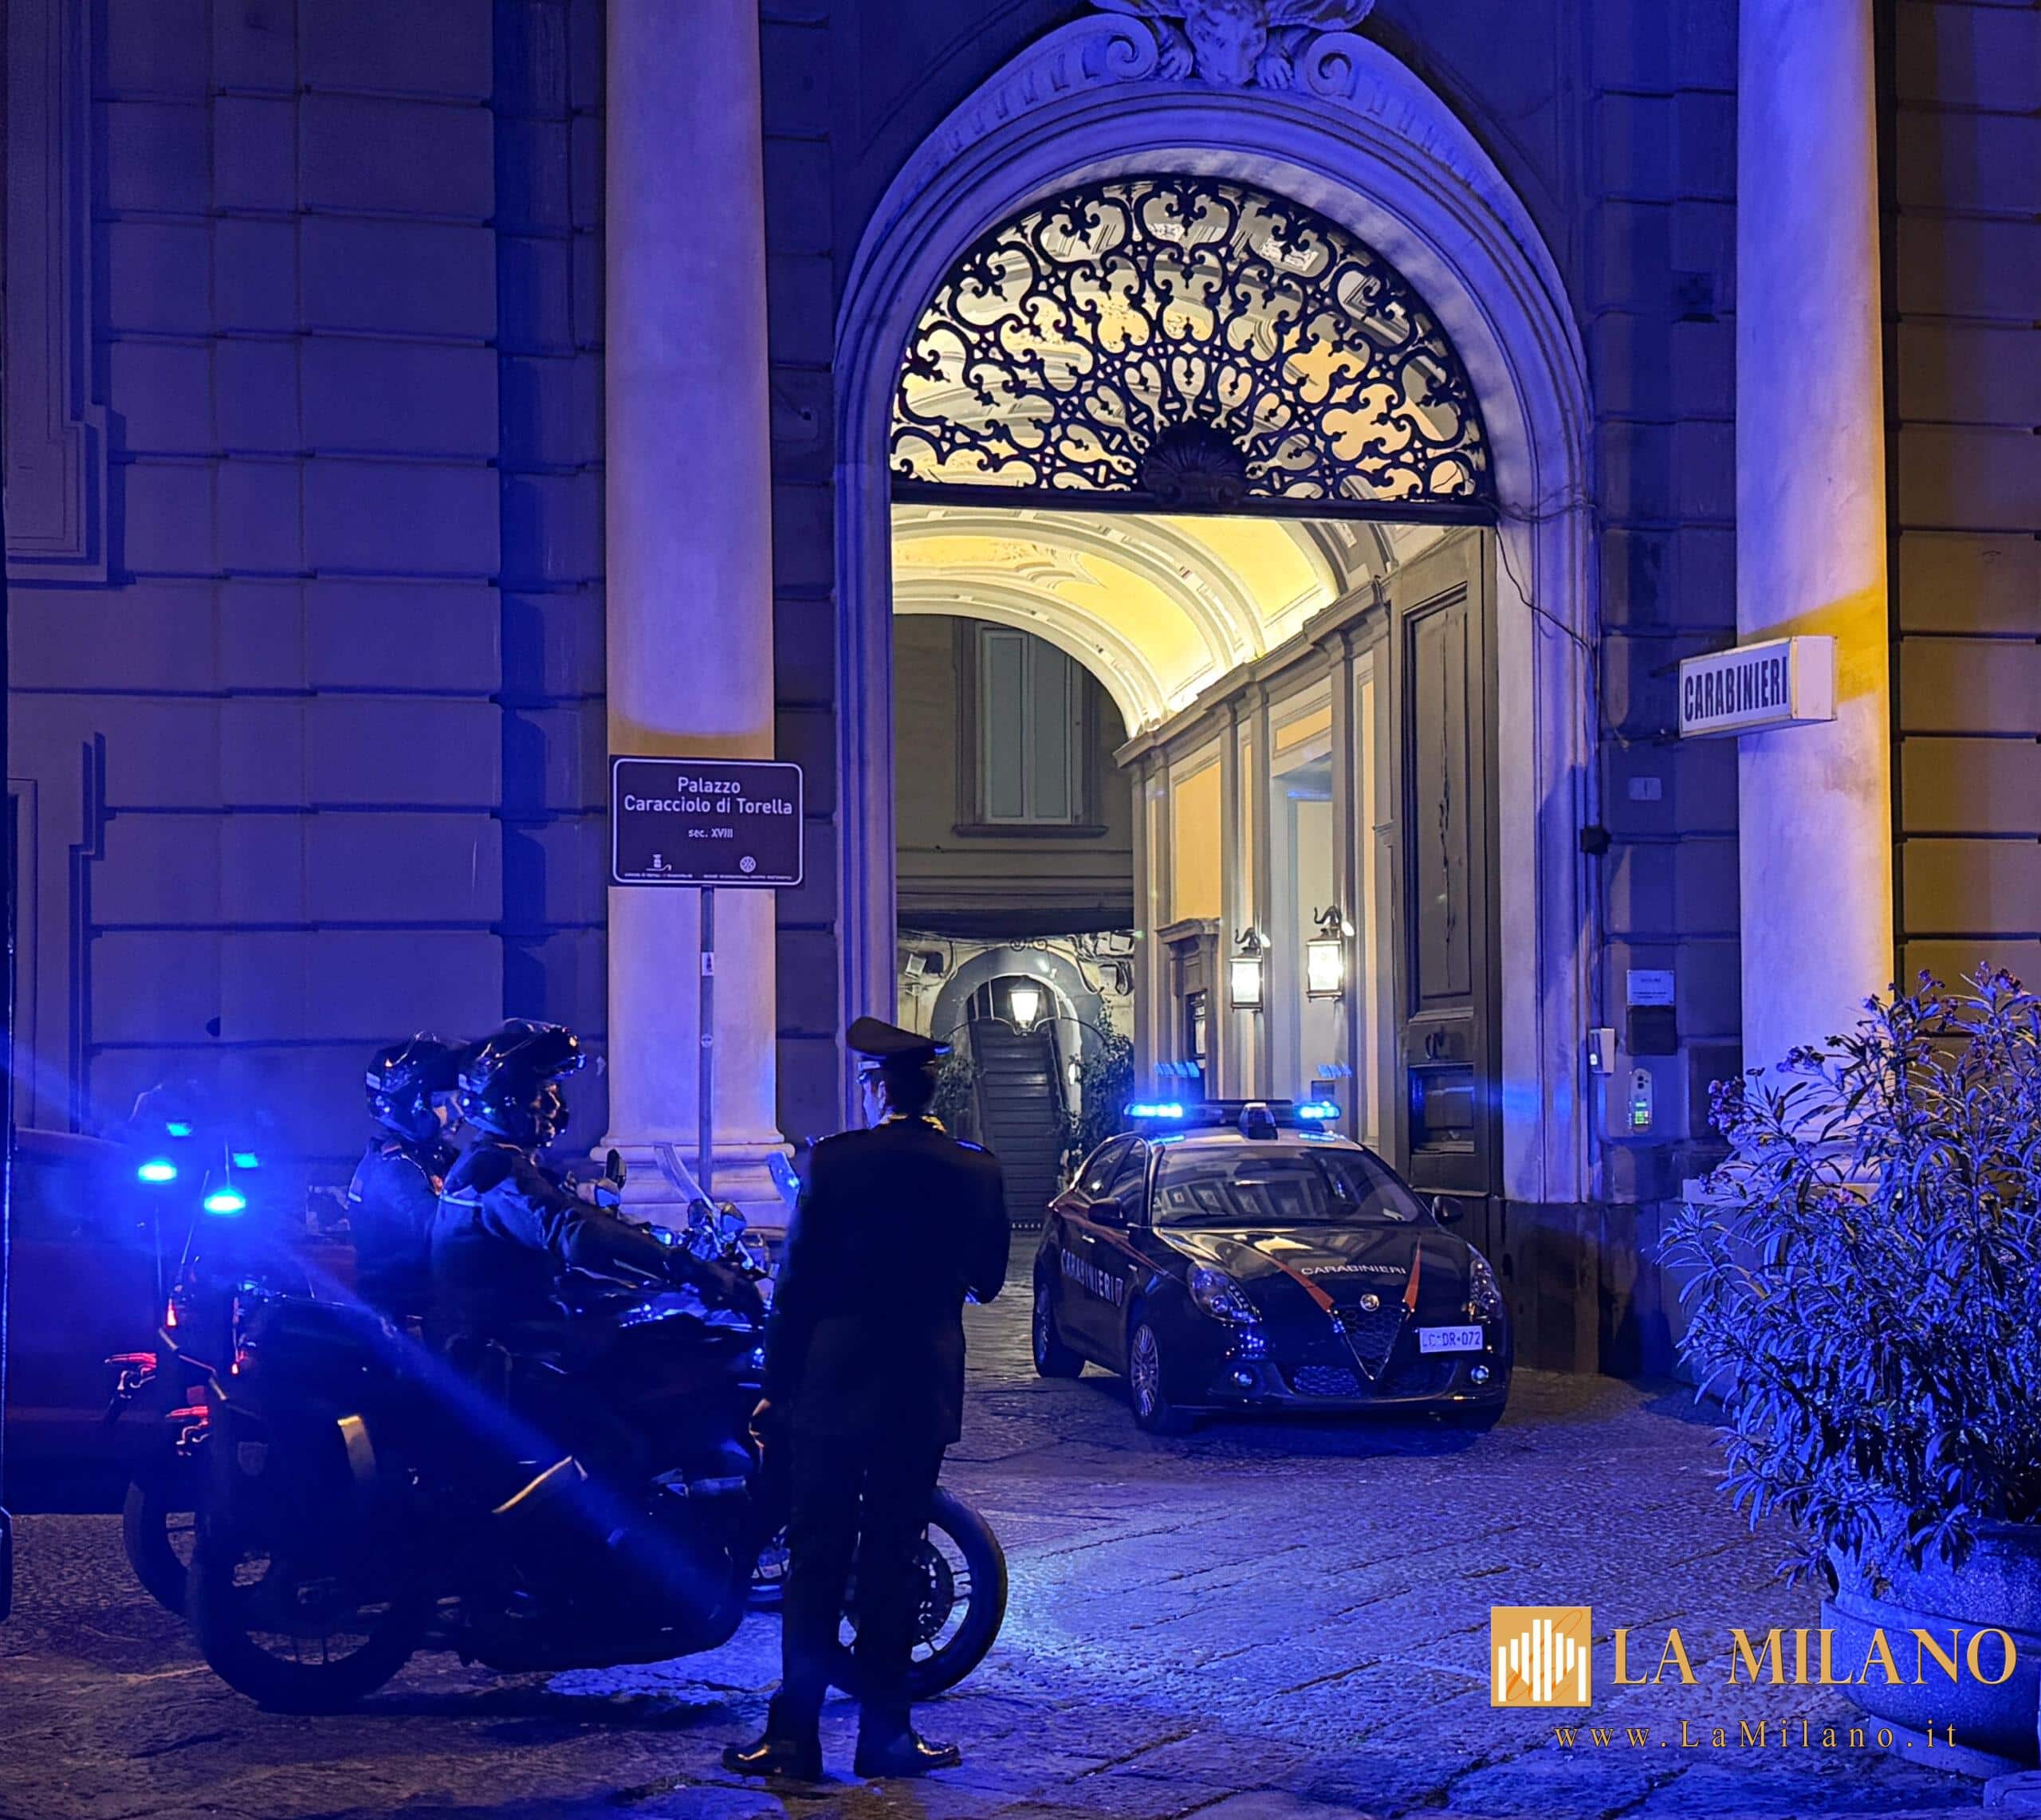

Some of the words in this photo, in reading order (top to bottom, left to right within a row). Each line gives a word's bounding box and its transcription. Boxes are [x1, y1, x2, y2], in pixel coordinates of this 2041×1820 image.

[1684, 655, 1787, 722] CARABINIERI
[678, 776, 741, 794] Palazzo
[624, 795, 711, 813] Caracciolo
[716, 797, 731, 814] di
[737, 798, 792, 815] Torella
[688, 829, 709, 839] sec.
[711, 828, 733, 839] XVIII
[1300, 1264, 1406, 1276] CARABINIERI
